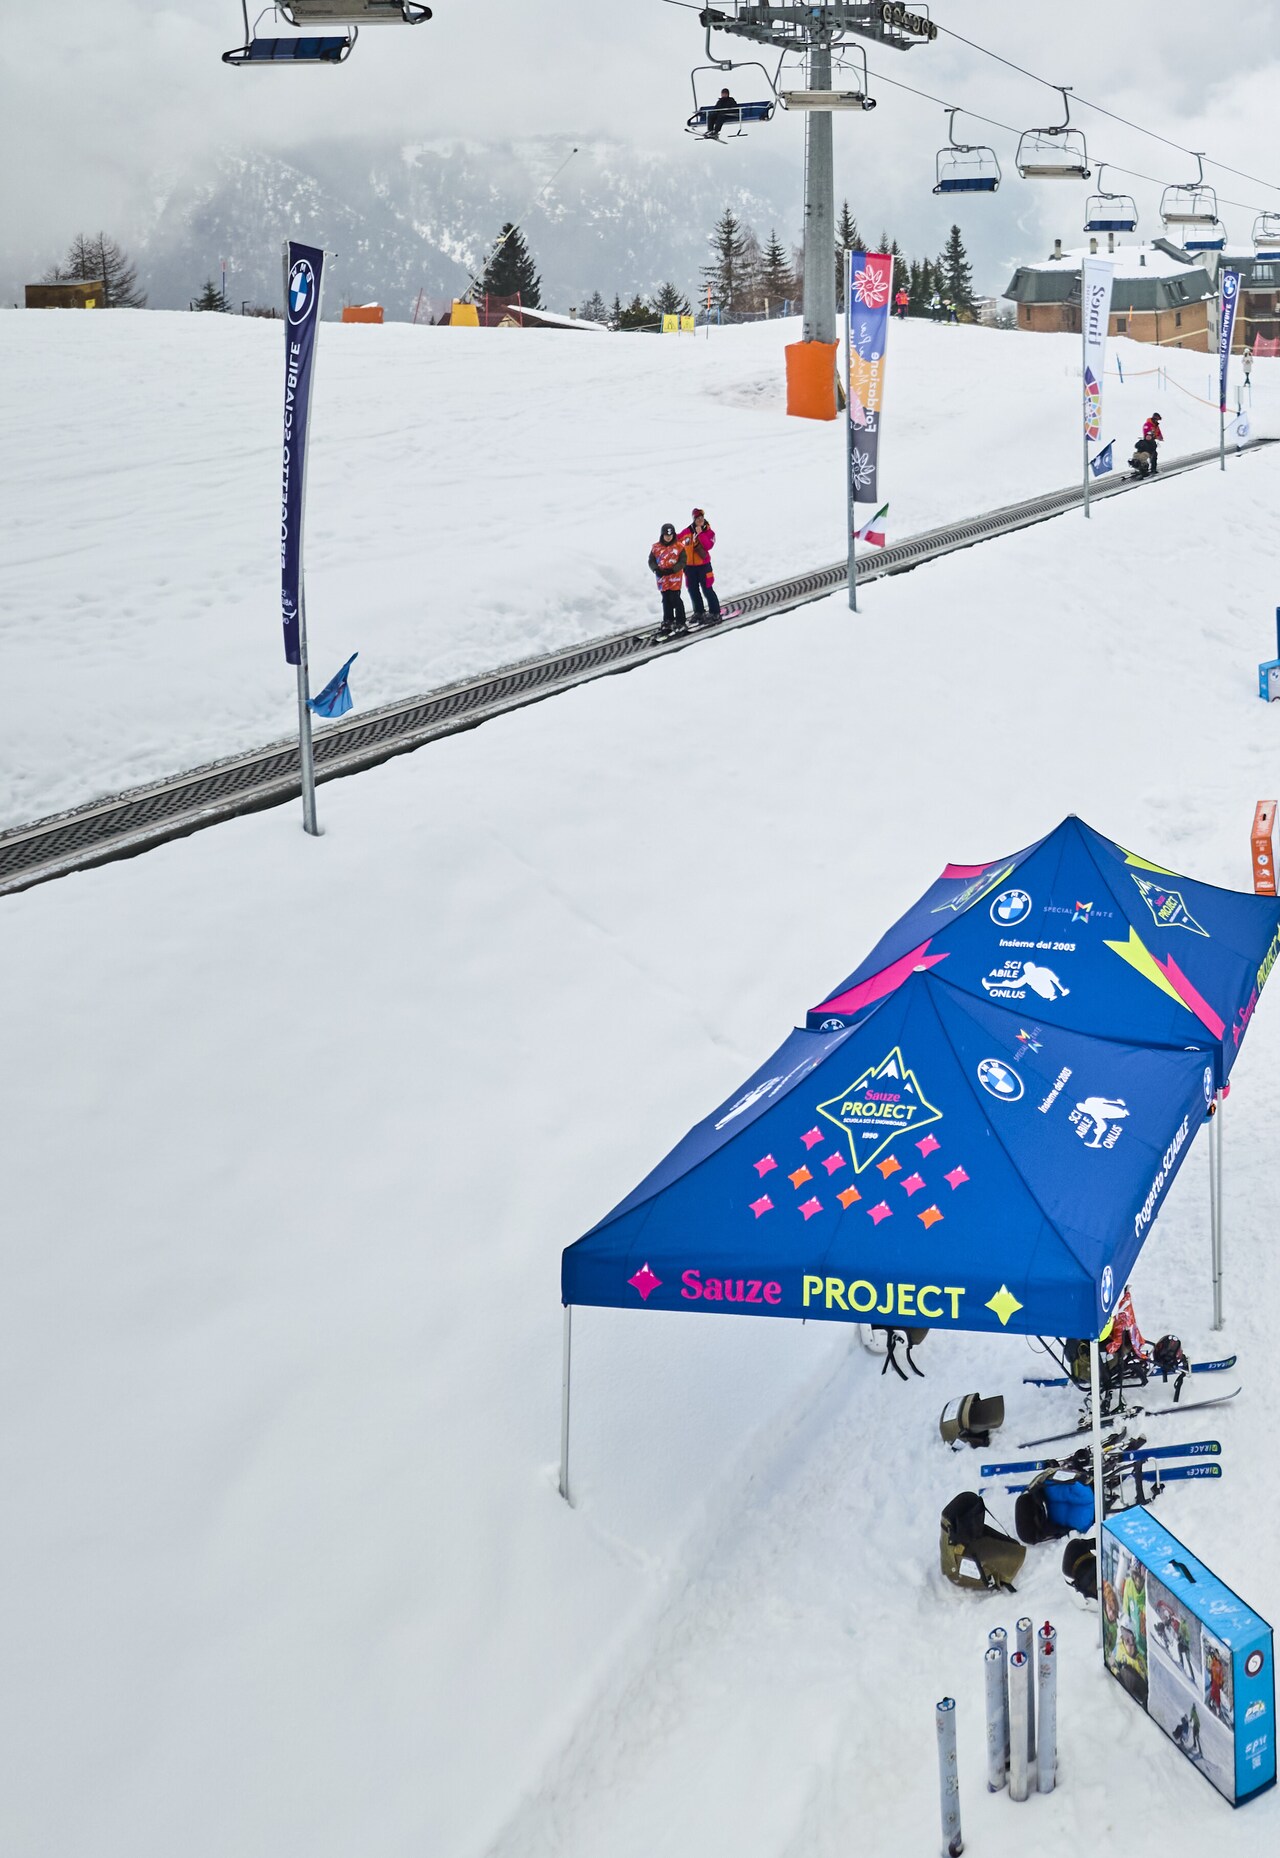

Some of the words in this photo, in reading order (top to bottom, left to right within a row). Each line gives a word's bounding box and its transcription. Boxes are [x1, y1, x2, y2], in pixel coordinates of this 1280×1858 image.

[999, 939, 1035, 949] Insieme
[1036, 940, 1051, 950] dal
[1052, 942, 1076, 952] 2003
[1003, 960, 1022, 970] SCI
[988, 968, 1020, 979] ABILE
[989, 989, 1026, 999] ONLUS
[864, 1089, 901, 1102] Sauze
[840, 1101, 917, 1120] PROJECT
[1068, 1109, 1083, 1125] SCI
[1075, 1116, 1094, 1139] ABILE
[1102, 1124, 1123, 1149] ONLUS
[1134, 1174, 1165, 1238] Progetto
[1162, 1114, 1190, 1178] SCIABILE
[680, 1269, 782, 1305] Sauze
[803, 1275, 966, 1319] PROJECT
